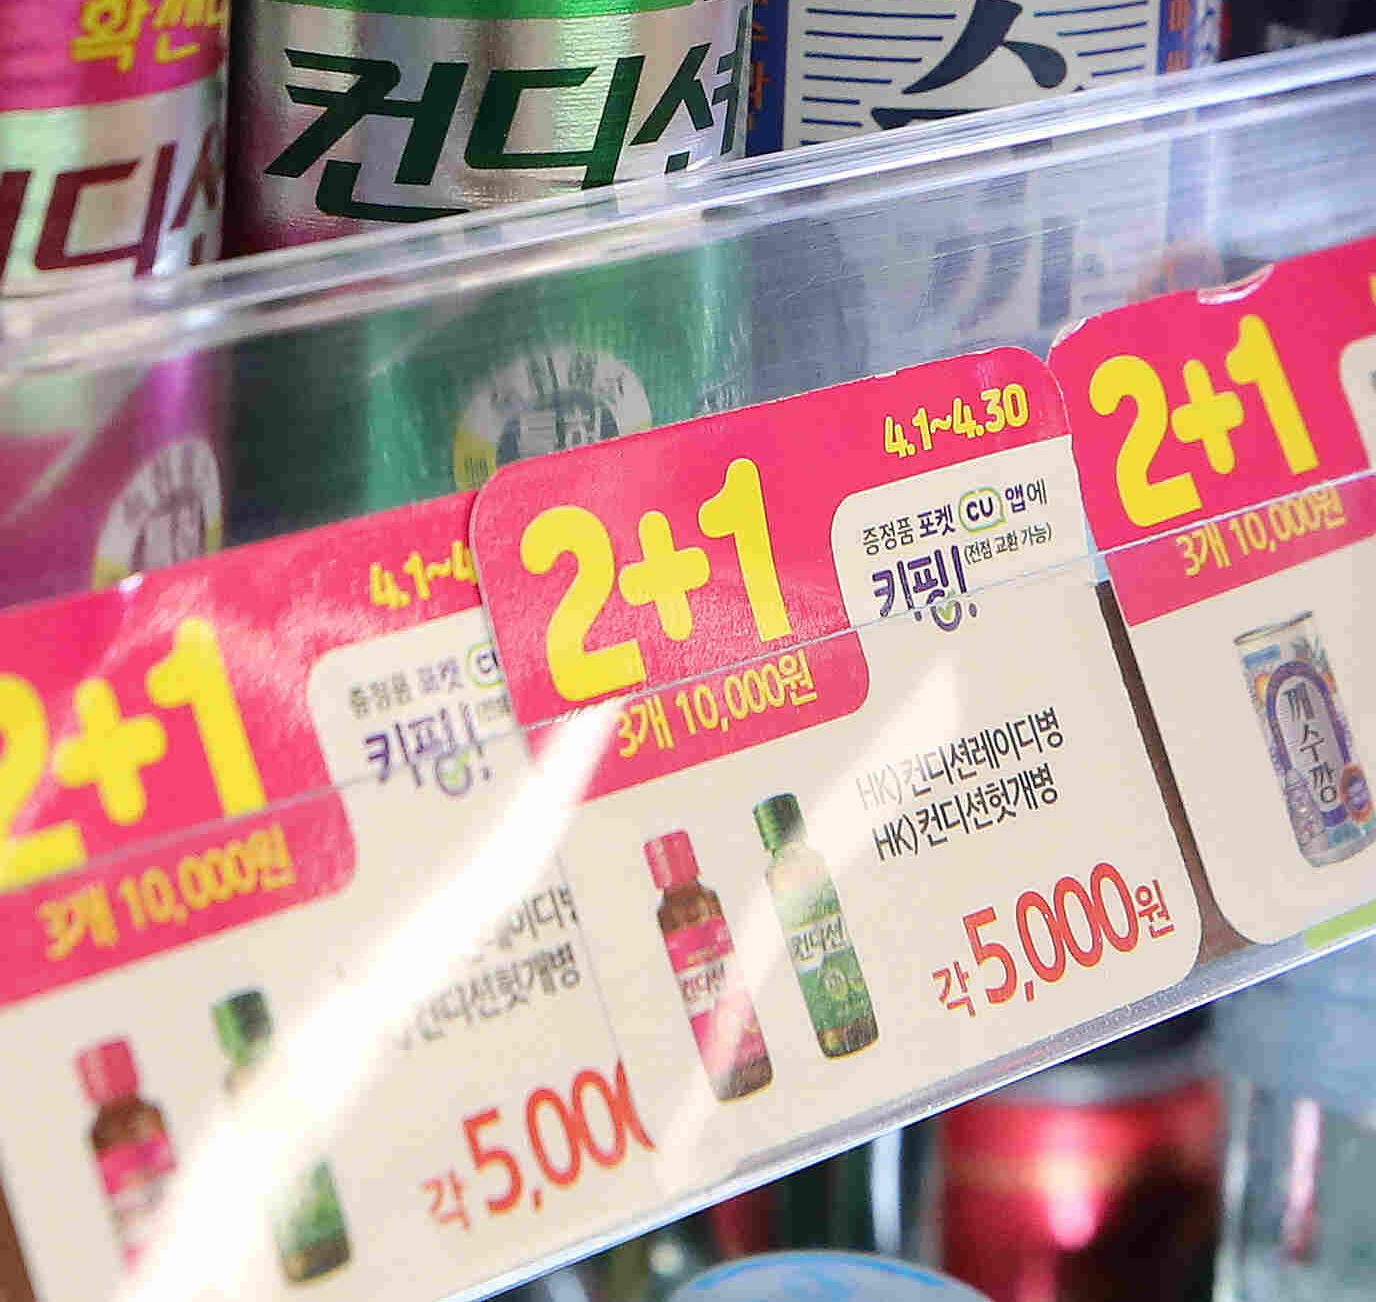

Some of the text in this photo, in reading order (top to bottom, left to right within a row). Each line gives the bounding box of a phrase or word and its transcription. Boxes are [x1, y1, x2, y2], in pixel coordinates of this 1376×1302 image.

[884, 384, 1030, 459] 4.1~4.30
[1088, 312, 1320, 529] 2+1
[863, 516, 915, 556] 증정품
[917, 504, 956, 538] 포켓
[965, 497, 995, 523] CU
[1177, 487, 1347, 579] 3개 10,000원
[521, 457, 793, 703] 2+1
[872, 545, 978, 632] 키핑!
[617, 651, 817, 760] 3개 10,000원
